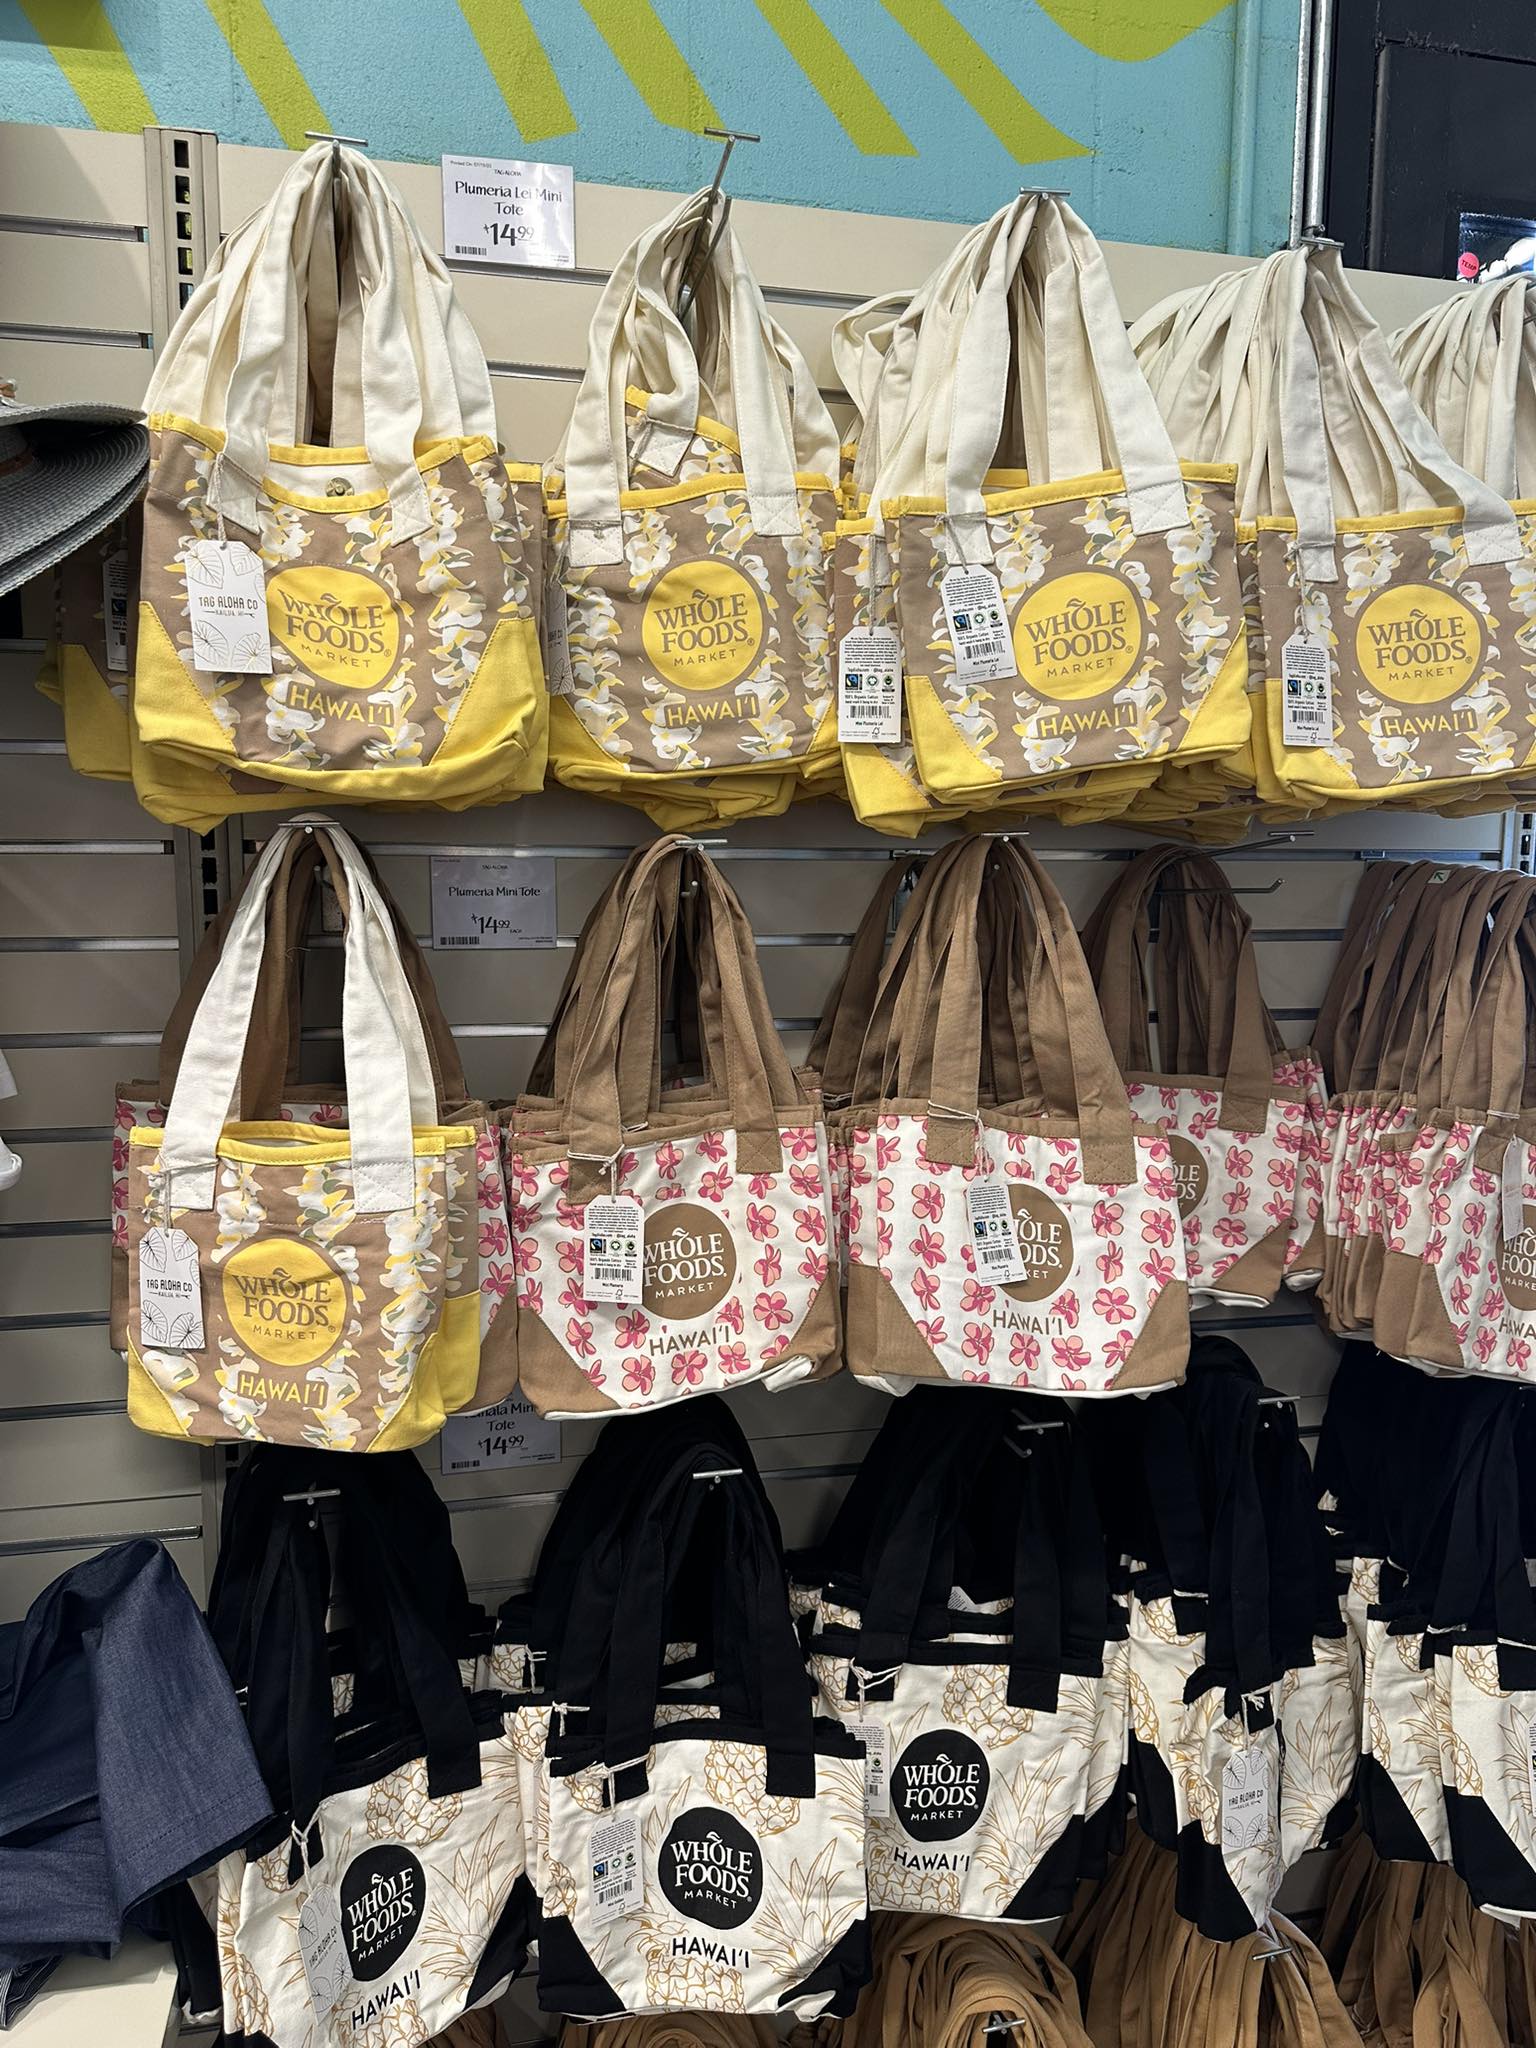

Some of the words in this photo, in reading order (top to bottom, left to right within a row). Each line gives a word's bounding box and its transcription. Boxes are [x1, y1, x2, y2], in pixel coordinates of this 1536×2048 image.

[455, 180, 512, 198] Plumeria
[515, 186, 532, 200] Lei
[535, 188, 562, 202] Mini
[493, 202, 524, 216] Tote
[1462, 260, 1477, 270] TEMP
[199, 596, 216, 608] TAG
[217, 596, 245, 610] ALOHA
[247, 599, 259, 610] CO
[277, 588, 386, 630] WHOLE
[653, 589, 748, 631] WHOLE
[286, 614, 386, 654] FOODS
[1024, 598, 1127, 643] WHOLE
[1366, 608, 1466, 646] WHOLE
[662, 619, 749, 654] FOODS
[1032, 626, 1127, 666] FOODS
[301, 643, 371, 669] MARKET
[673, 648, 737, 667] MARKET
[1375, 638, 1467, 669] FOODS
[1047, 657, 1115, 679] MARKET
[1388, 665, 1455, 681] MARKET
[448, 886, 494, 897] Plumeria
[496, 886, 518, 897] Mini
[518, 886, 541, 897] Tote
[644, 1227, 724, 1265] WHOLE
[232, 1267, 332, 1304] WHOLE
[643, 1255, 725, 1288] FOODS
[1504, 1276, 1536, 1291] MARKE
[146, 1279, 159, 1290] TAG
[161, 1279, 182, 1291] ALOHA
[183, 1281, 193, 1293] CO
[655, 1282, 714, 1299] MARKET
[243, 1296, 330, 1328] FOODS
[253, 1324, 318, 1341] MARKET
[487, 1420, 516, 1431] Tote
[903, 1754, 980, 1786] WHOLE
[904, 1785, 977, 1809] FOODS
[1228, 1795, 1239, 1807] TAG
[1240, 1790, 1256, 1804] ALOHA
[1256, 1789, 1264, 1798] CO
[910, 1810, 964, 1821] MARKET
[670, 1831, 753, 1874] WHOLE
[675, 1863, 749, 1899] FOODS
[347, 1867, 414, 1927] WHOLE
[684, 1890, 737, 1909] MARKET
[351, 1892, 414, 1952] FOODS
[358, 1925, 404, 1962] MARKET
